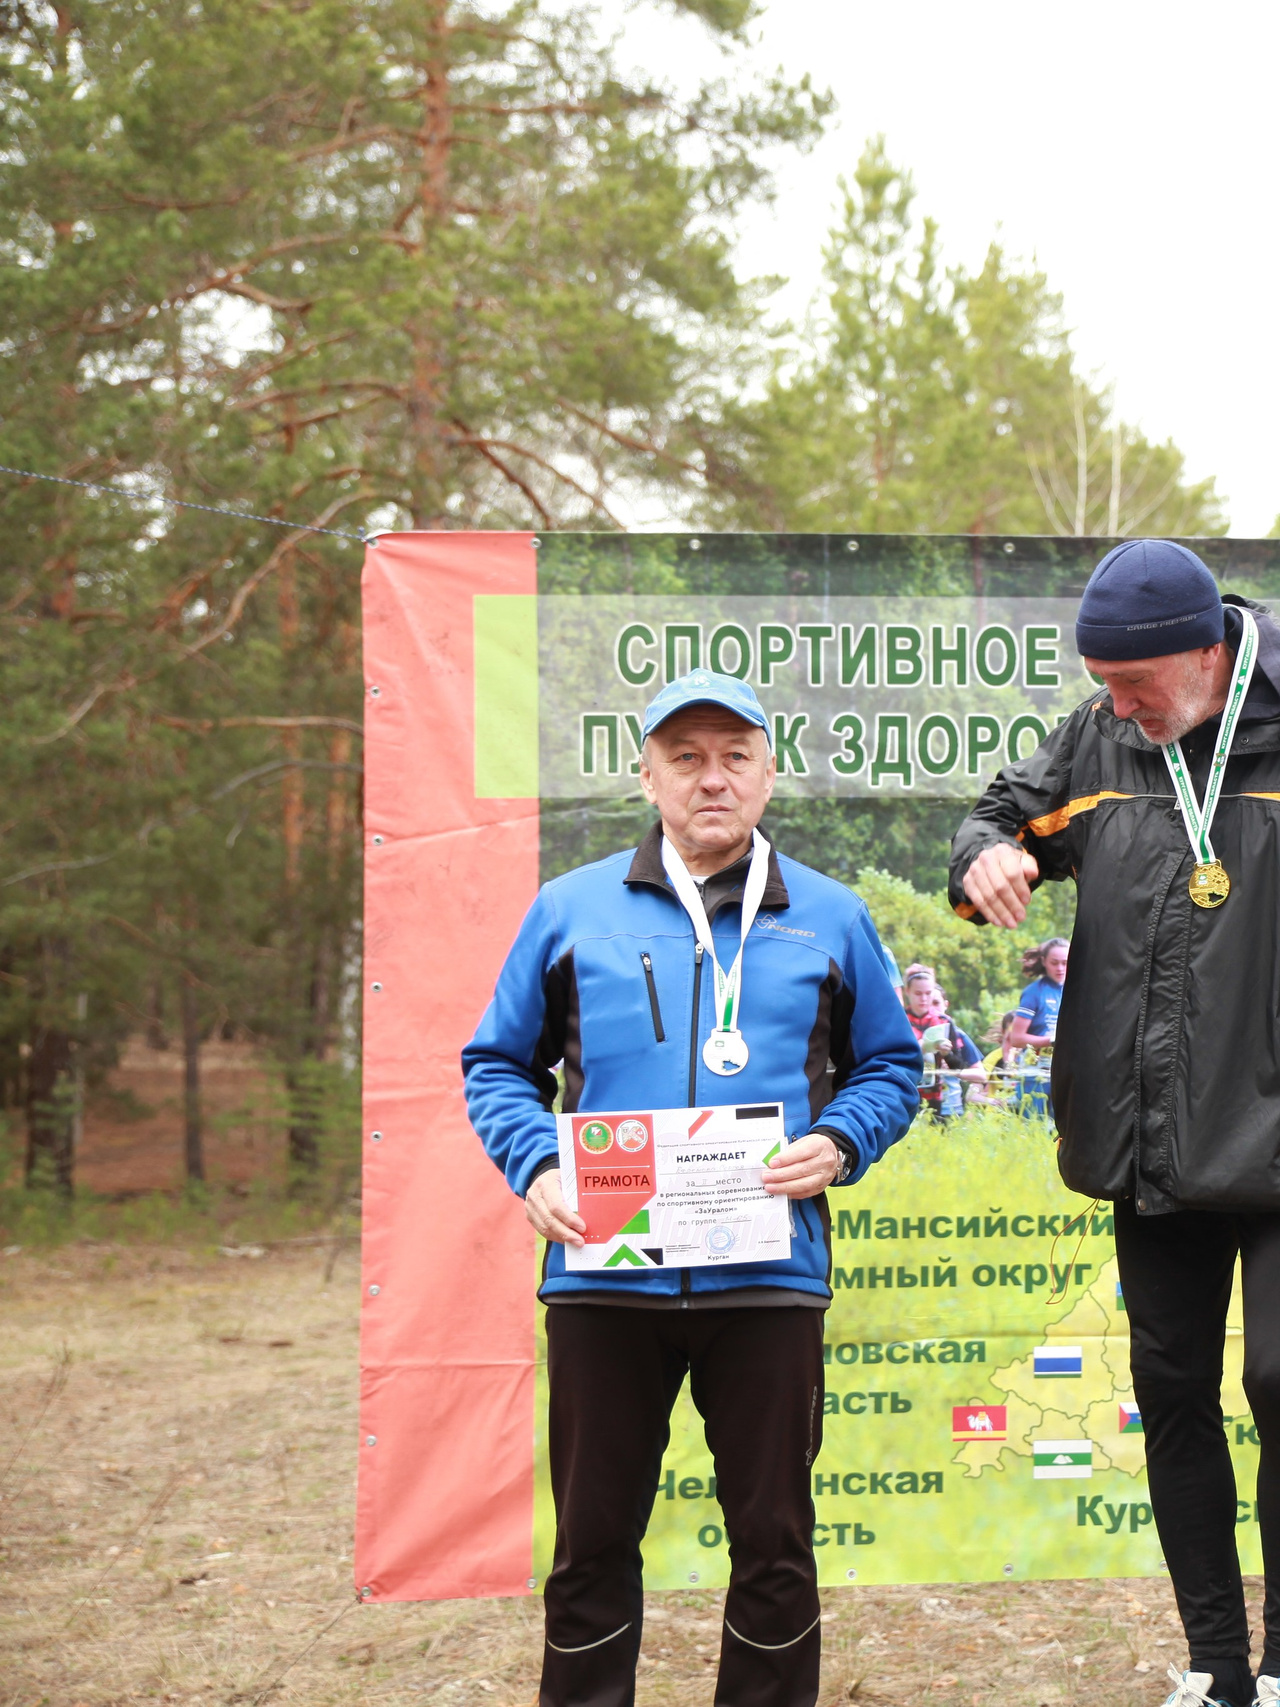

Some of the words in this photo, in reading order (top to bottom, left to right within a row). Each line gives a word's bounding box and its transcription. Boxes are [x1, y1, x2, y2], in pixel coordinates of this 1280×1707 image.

[616, 624, 1059, 686] СПОРТИВНОЕ
[767, 924, 816, 938] NORD
[676, 1151, 747, 1164] НАГРАЖДАЕТ
[584, 1174, 651, 1188] ГРАМОТА
[666, 1190, 716, 1199] региональных
[667, 1198, 713, 1207] спортивному
[714, 1194, 775, 1204] ориентированию
[691, 1217, 717, 1226] группе
[972, 1262, 1092, 1294] округ
